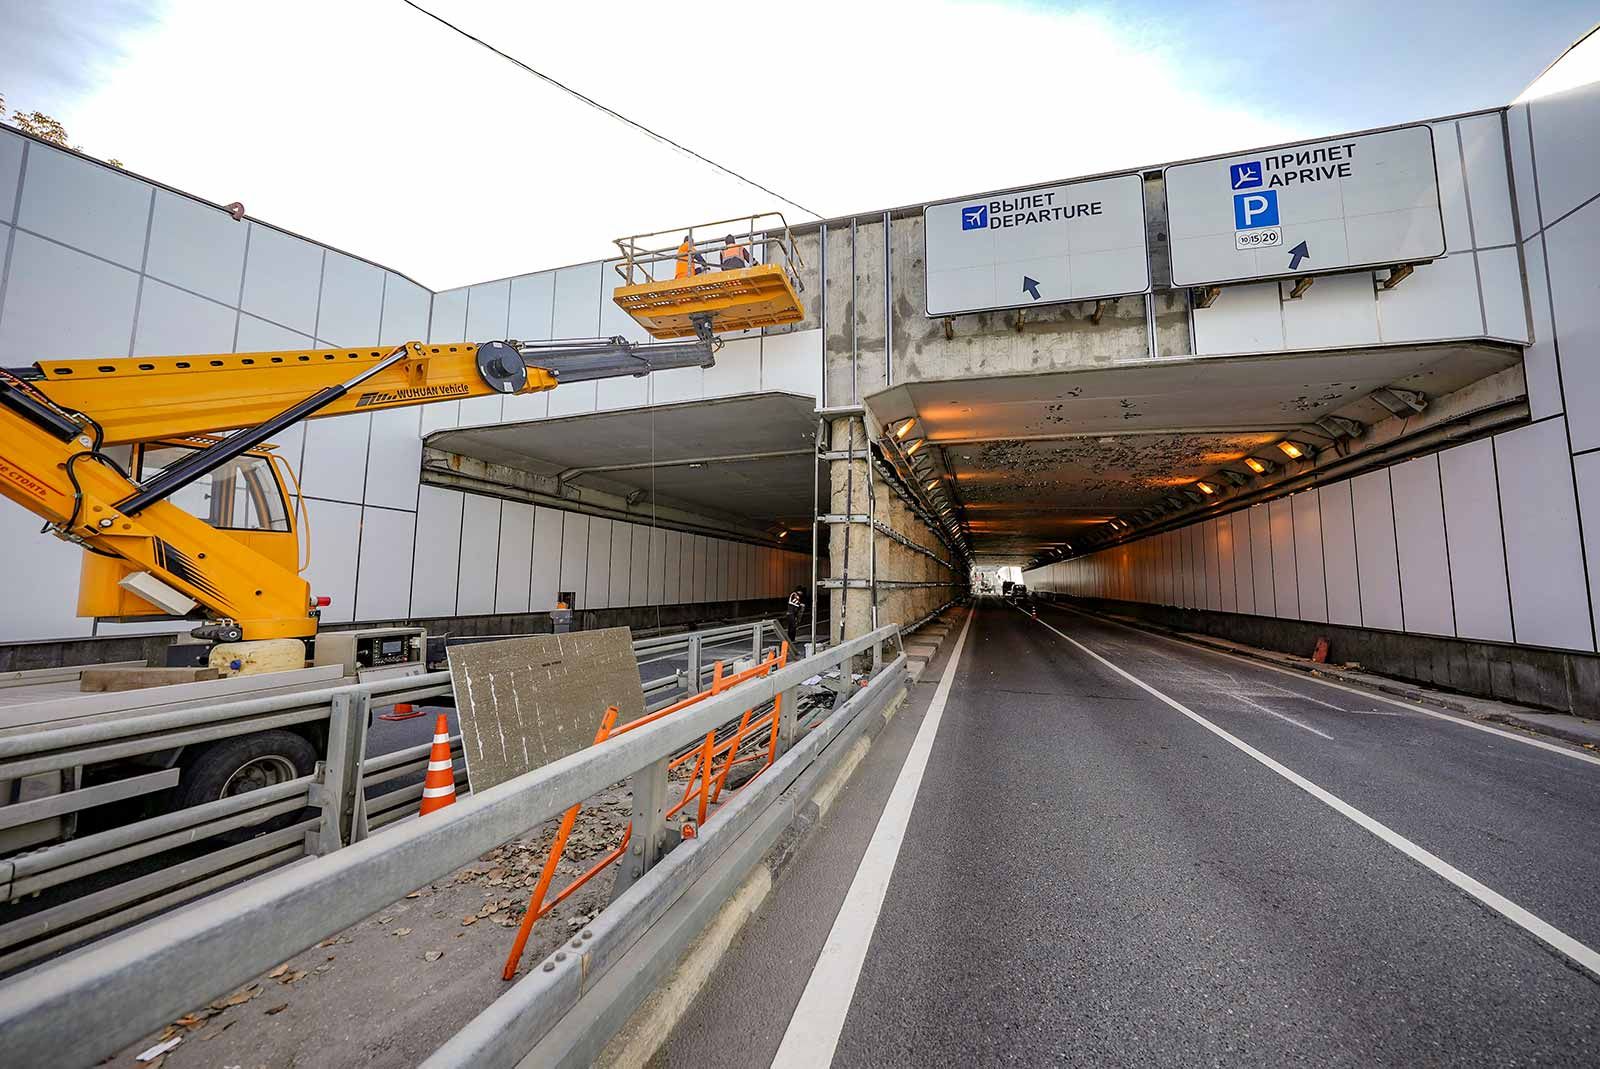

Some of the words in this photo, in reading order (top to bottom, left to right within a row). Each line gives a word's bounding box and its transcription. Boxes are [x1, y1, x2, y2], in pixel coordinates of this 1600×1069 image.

[1265, 143, 1356, 171] ПРИЛЕТ
[1268, 162, 1352, 188] APRIVE
[989, 192, 1055, 214] ВЫЛЕТ
[990, 201, 1102, 229] DEPARTURE
[1243, 195, 1269, 225] P
[1250, 234, 1260, 243] 15
[1262, 232, 1276, 242] 20
[396, 385, 439, 399] WUHUAN
[439, 383, 469, 395] Vehicle
